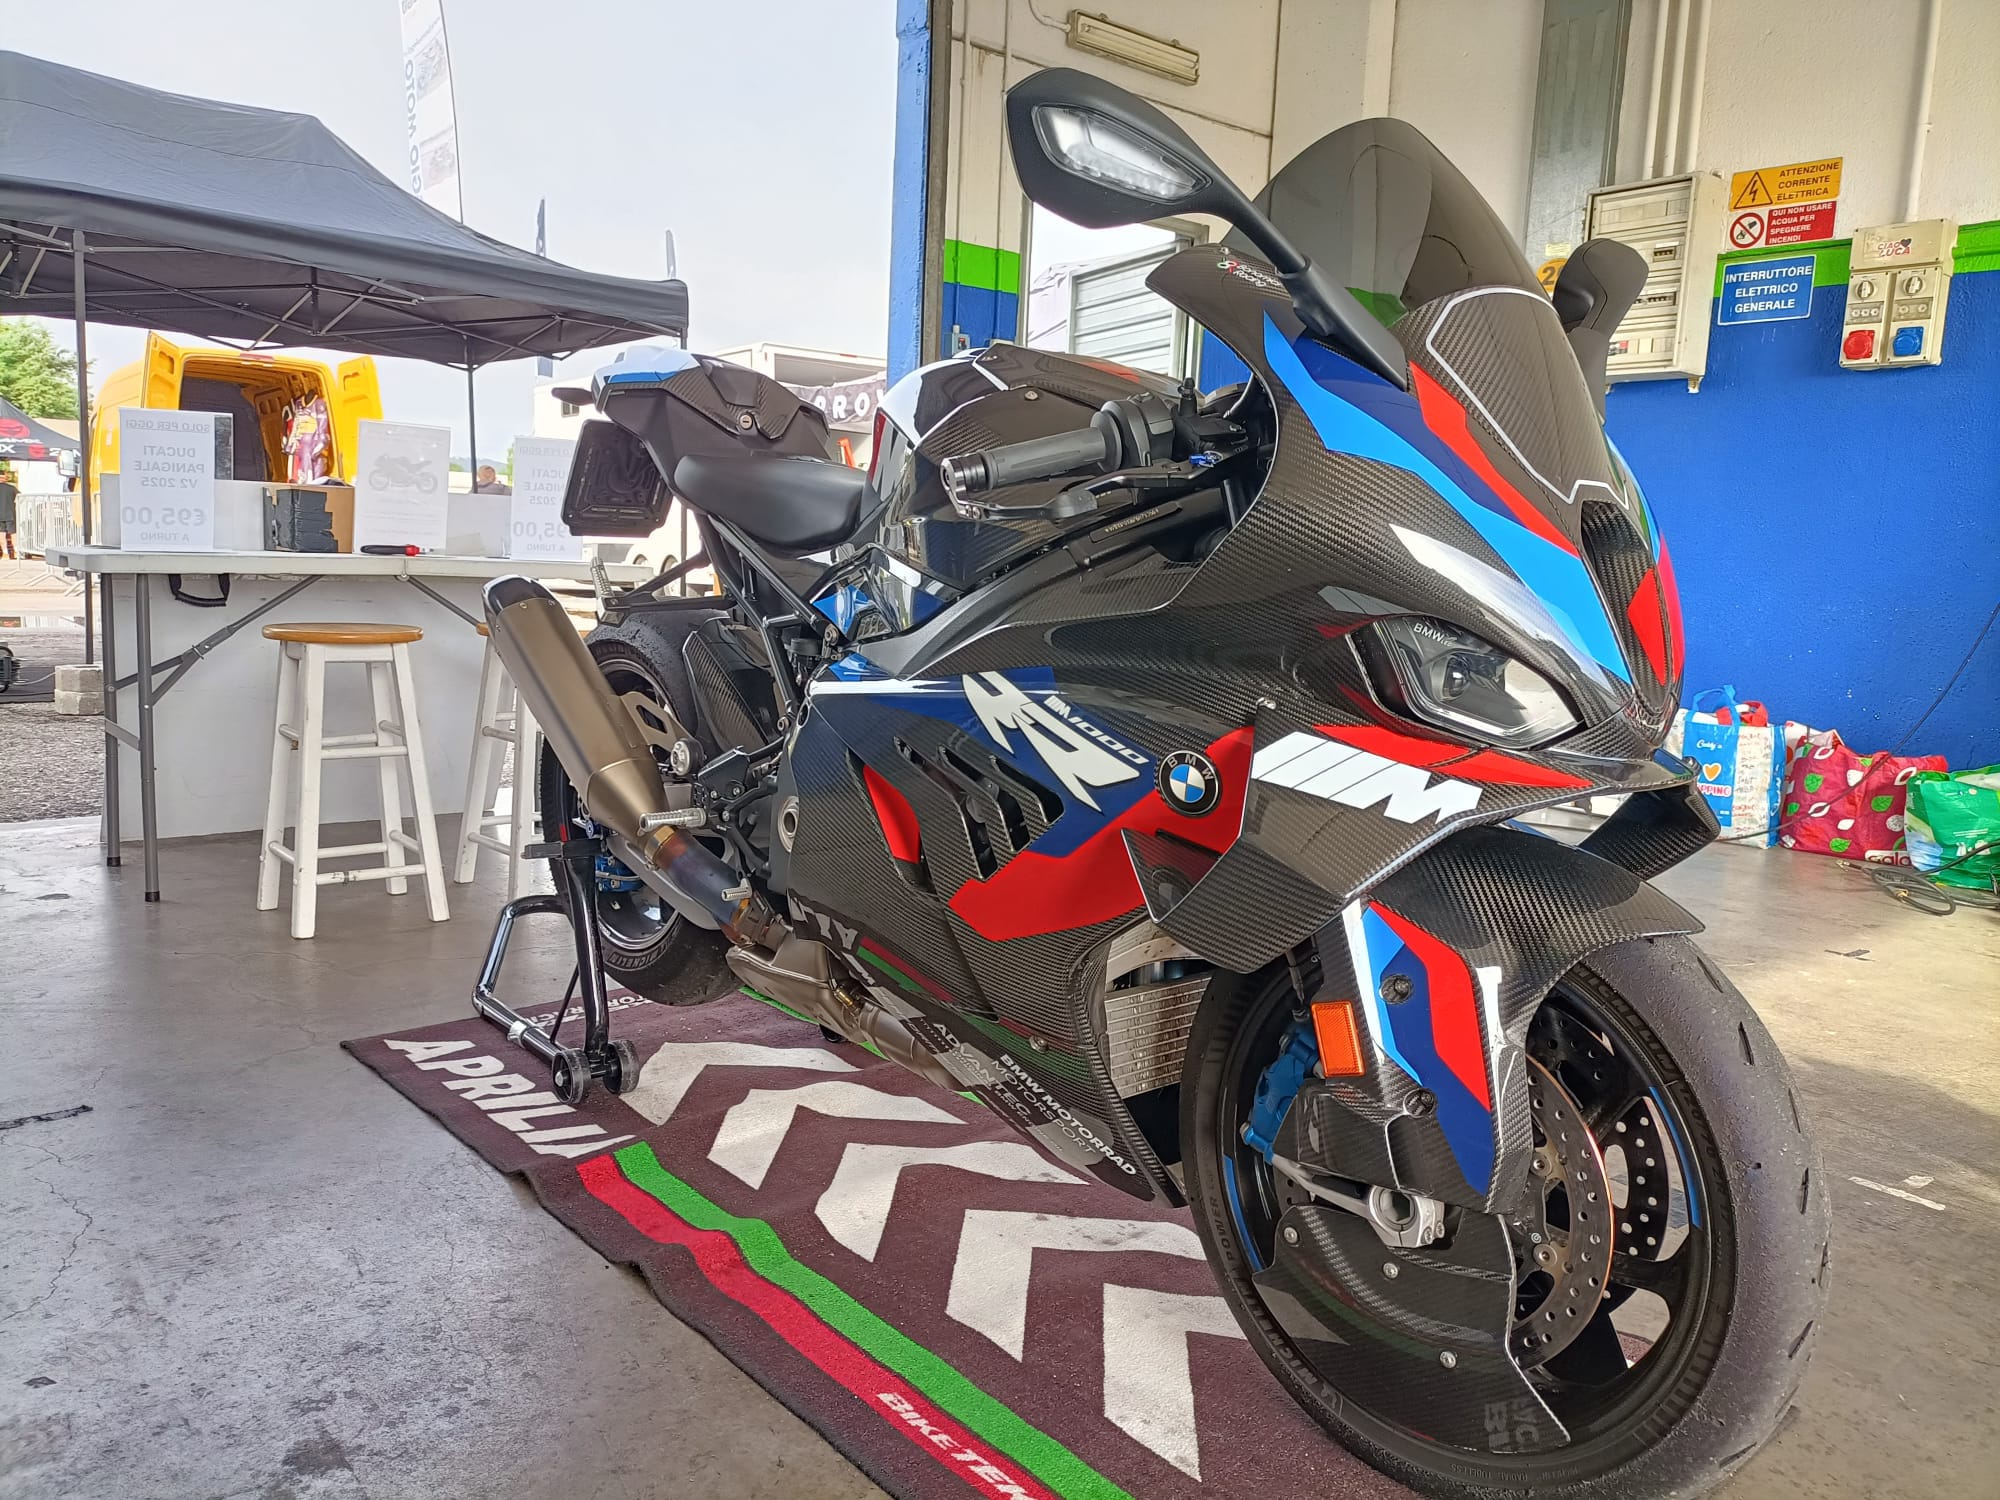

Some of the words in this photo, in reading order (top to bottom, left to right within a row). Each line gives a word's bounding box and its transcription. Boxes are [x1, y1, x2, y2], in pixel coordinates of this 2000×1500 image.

[1780, 161, 1840, 178] ATTENZIONE
[1778, 175, 1831, 189] CORRENTE
[1777, 187, 1829, 201] ELETTRICA
[1772, 208, 1786, 217] QUI
[1787, 206, 1805, 215] NON
[1806, 202, 1833, 212] USARE
[1771, 217, 1798, 226] ACQUA
[1799, 214, 1815, 223] PER
[1770, 224, 1811, 235] SPEGNERE
[1769, 235, 1801, 244] INCENDI
[1878, 241, 1900, 250] CIAO
[1880, 247, 1911, 257] LUCA
[1725, 265, 1812, 284] INTERRUTTORE
[1735, 282, 1798, 298] ELETTRICO
[1734, 299, 1796, 314] GENERALE
[1413, 622, 1445, 643] BMW
[1166, 753, 1215, 781] BMW
[933, 1023, 1031, 1117] ADVANTEC
[991, 1060, 1098, 1154] MOTORSPORT
[1000, 1053, 1045, 1094] BMW
[1042, 1092, 1137, 1176] MOTORRAD
[1209, 1195, 1234, 1262] POWER
